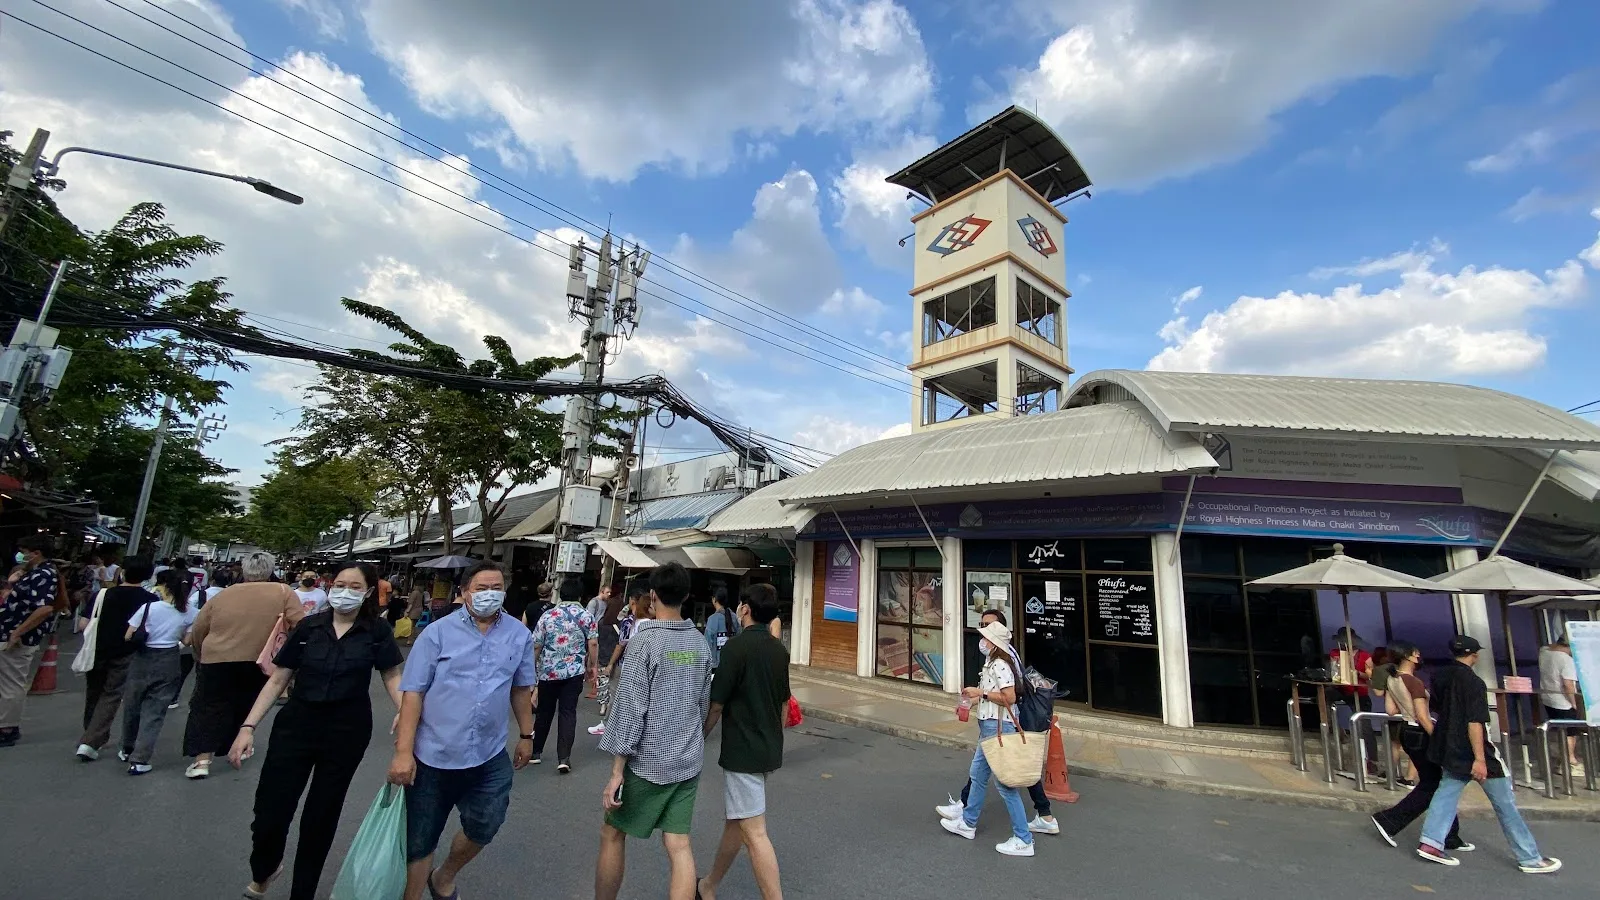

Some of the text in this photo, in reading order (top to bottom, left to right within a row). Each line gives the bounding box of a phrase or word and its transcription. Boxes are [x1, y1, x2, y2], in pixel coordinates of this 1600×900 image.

[1178, 500, 1194, 509] Te
[1198, 502, 1250, 512] Occupational
[1254, 504, 1296, 514] Promotion
[1300, 506, 1327, 516] Project
[1344, 509, 1376, 517] Initiated
[1380, 510, 1390, 520] by
[1200, 514, 1222, 524] Royal
[1226, 516, 1262, 525] Highness
[1266, 517, 1299, 526] Princess
[1302, 519, 1325, 528] Maha
[1329, 520, 1355, 529] Chakri
[1358, 522, 1400, 531] Sirindhorn
[1098, 578, 1146, 592] Phufa Coffee
